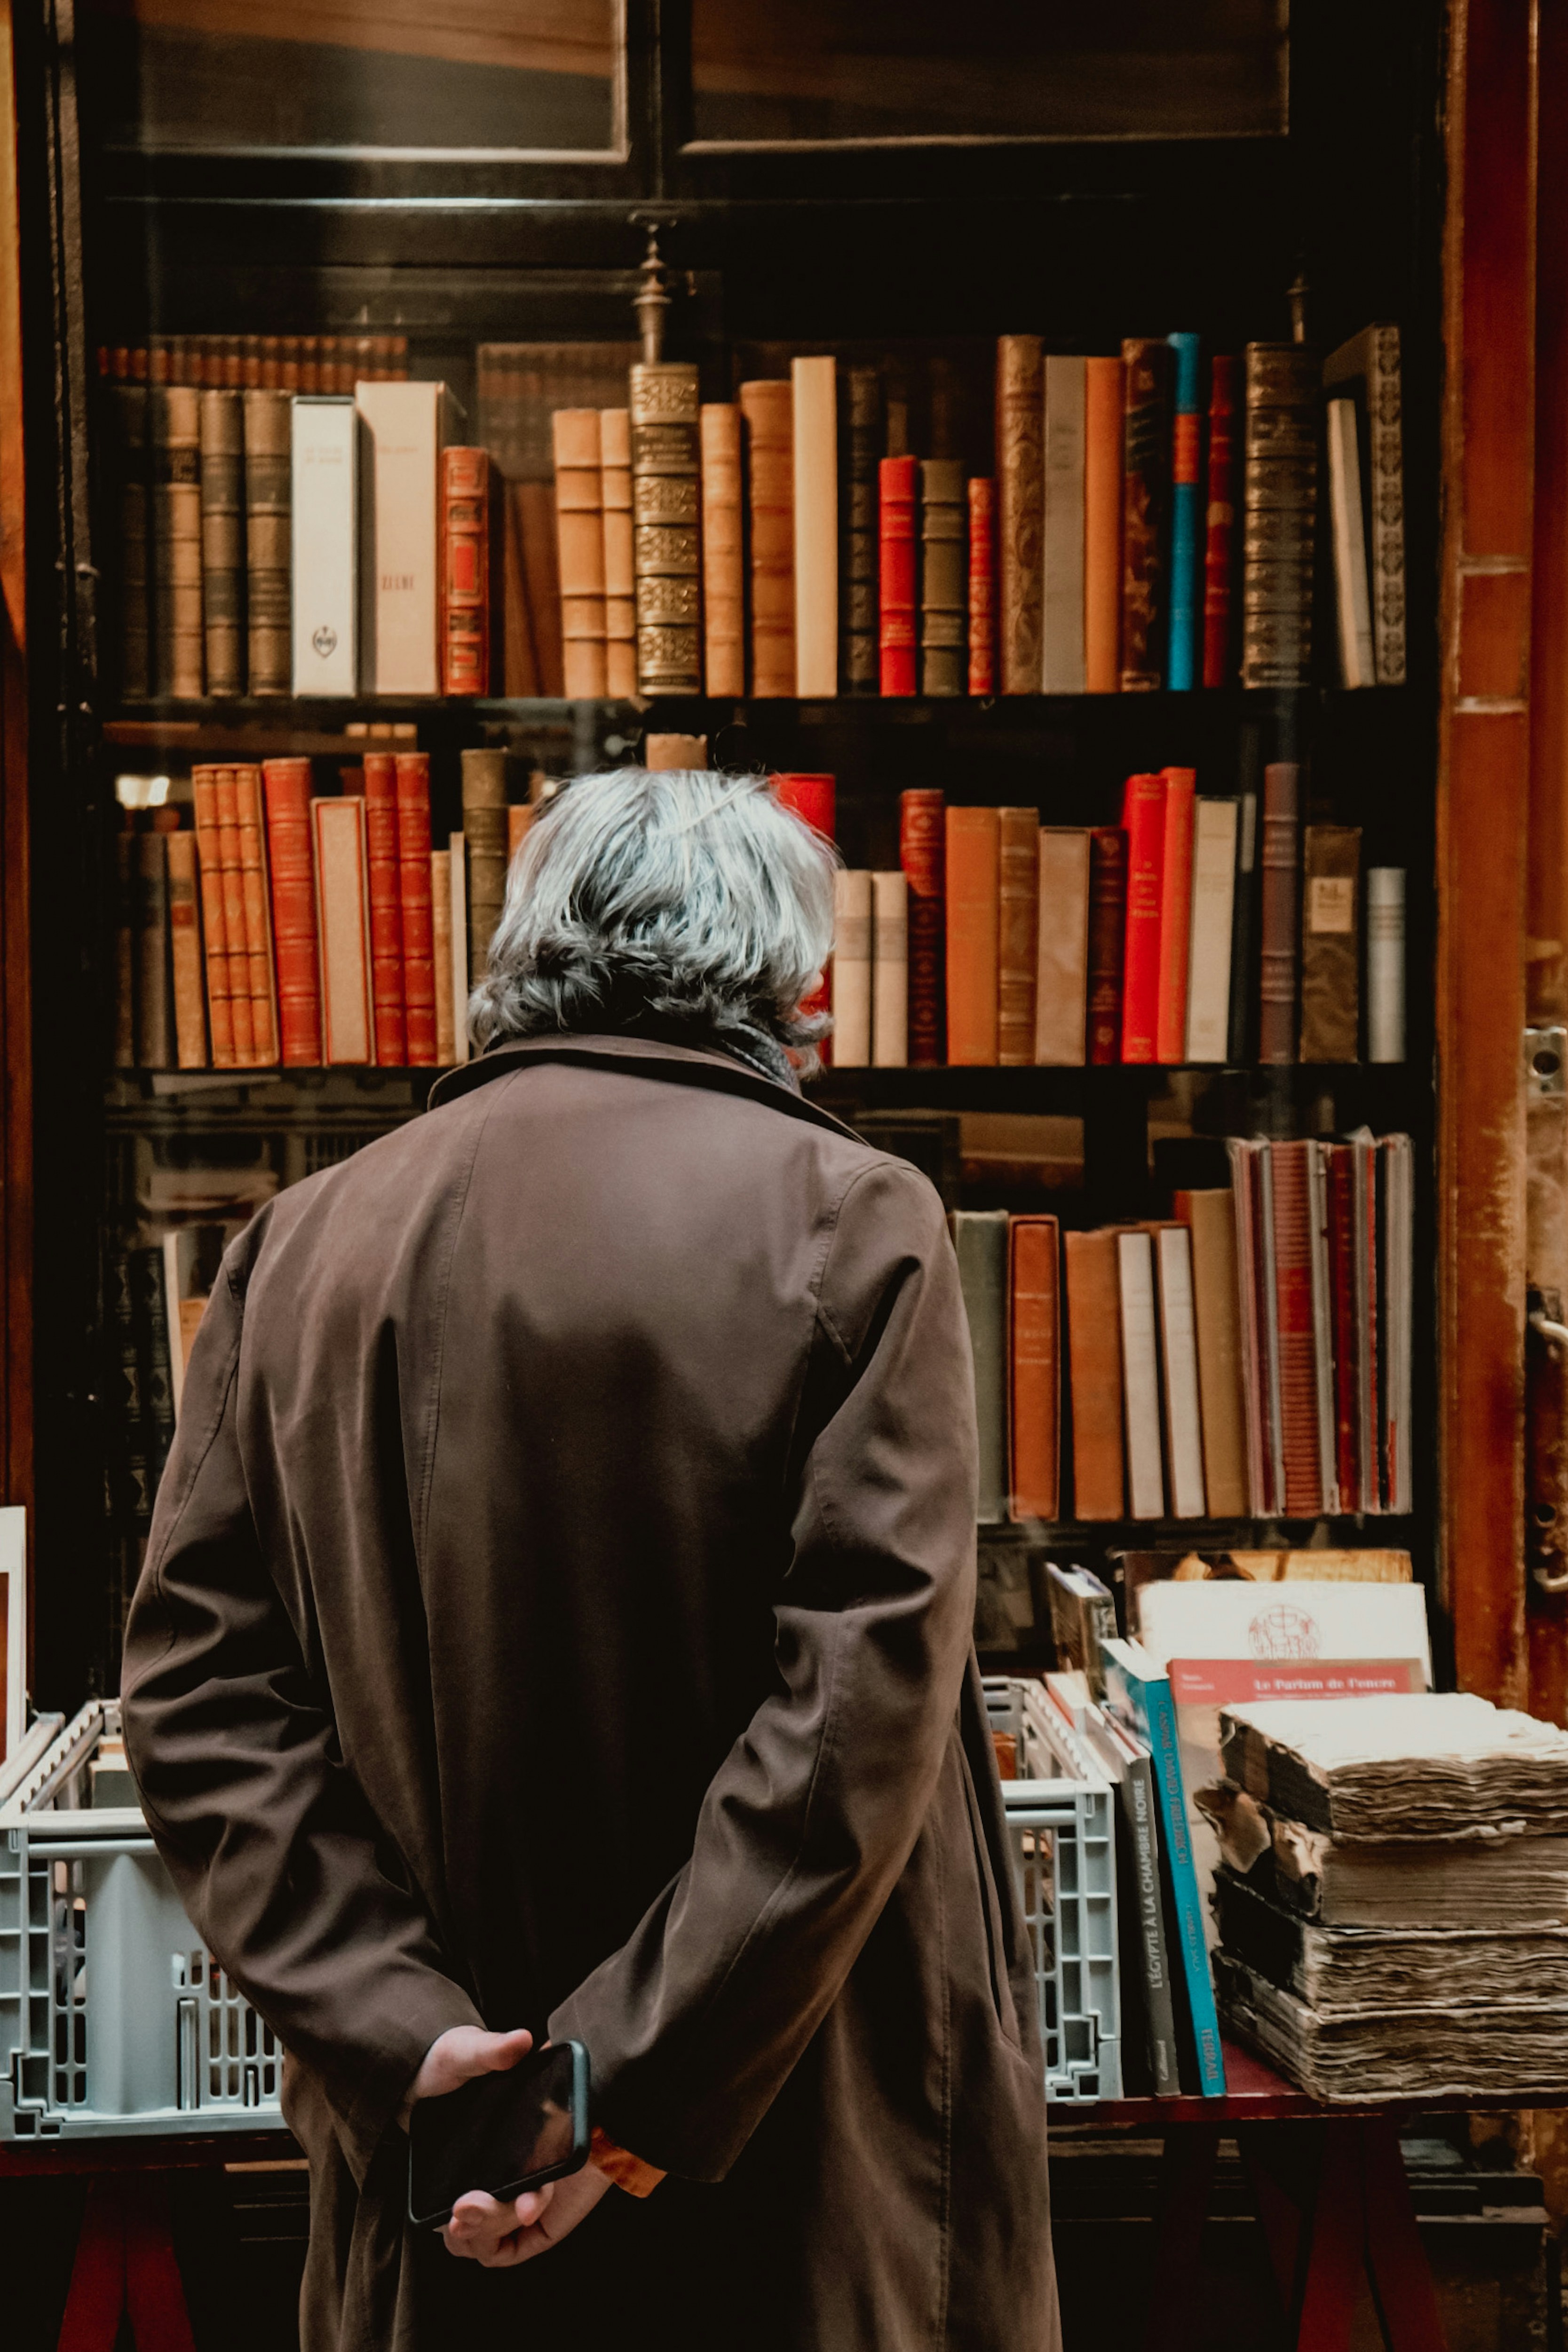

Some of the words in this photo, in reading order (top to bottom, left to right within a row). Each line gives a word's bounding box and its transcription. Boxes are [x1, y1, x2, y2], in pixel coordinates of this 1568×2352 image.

[1254, 1679, 1271, 1691] Le
[1274, 1678, 1323, 1690] Parfum
[1327, 1677, 1345, 1689] de
[1158, 1701, 1172, 1749] CASPAR
[1164, 1753, 1179, 1795] DAVID
[1133, 1780, 1148, 1822] NOIRE
[1169, 1796, 1188, 1864] FRIEDRICH
[1138, 1826, 1154, 1893] CHAMBRE
[1143, 1896, 1156, 1913] LA
[1143, 1916, 1157, 1927] À
[1147, 1931, 1163, 1988] L'ÉGYPTE
[1157, 2040, 1169, 2081] Gallimard
[1202, 2028, 1219, 2081] TERRAIL
